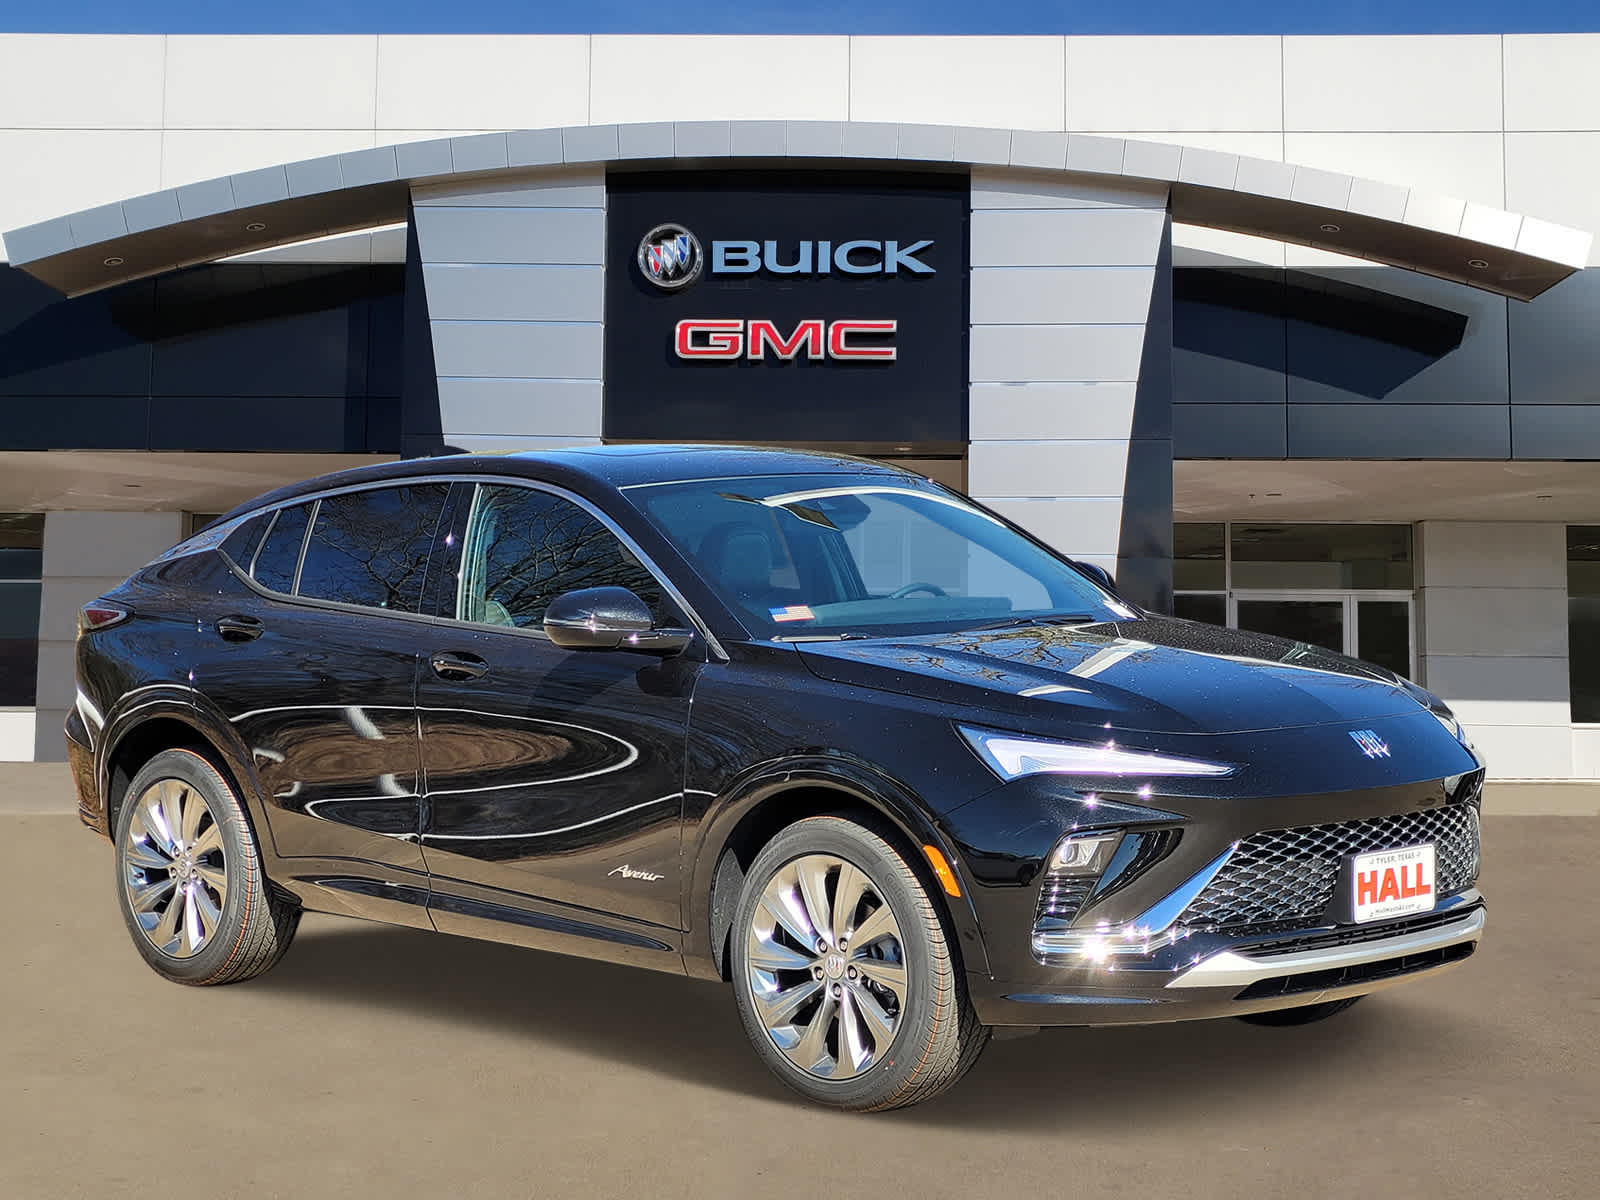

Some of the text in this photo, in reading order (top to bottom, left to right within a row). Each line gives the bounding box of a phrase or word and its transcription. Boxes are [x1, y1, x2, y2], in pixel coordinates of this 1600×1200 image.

[712, 240, 936, 273] BUICK
[675, 319, 897, 360] GMC
[1398, 852, 1415, 861] TEXAS
[1357, 862, 1431, 906] HALL
